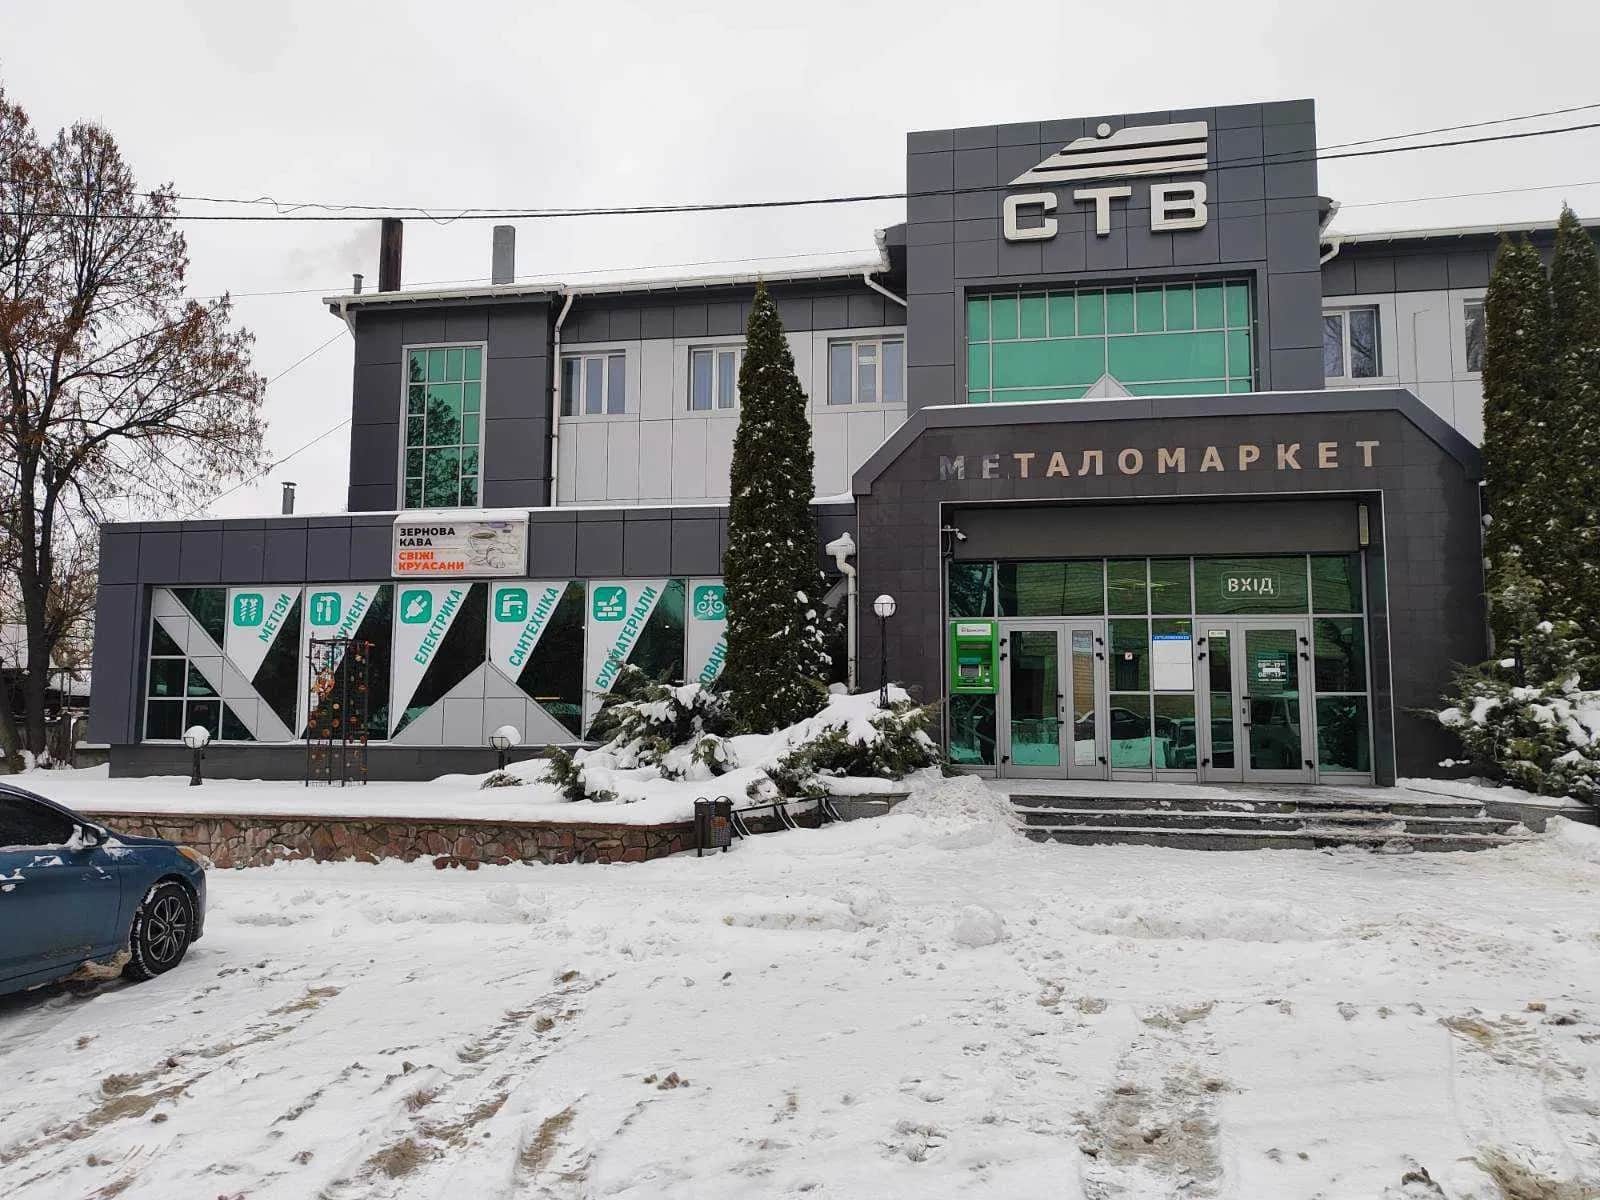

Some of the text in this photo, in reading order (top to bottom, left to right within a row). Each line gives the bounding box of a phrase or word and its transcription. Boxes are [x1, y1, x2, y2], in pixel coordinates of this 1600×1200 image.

[1004, 181, 1207, 240] СТВ
[938, 440, 1381, 481] МЕТАЛОМАРКЕТ
[400, 527, 456, 537] ЗЕРНОВА
[400, 538, 433, 547] КАВА
[398, 551, 434, 561] СВІЖІ
[398, 561, 465, 571] КРУАСАНИ
[1228, 577, 1274, 595] ВХІД
[258, 593, 292, 643] МЕТІЗИ
[413, 589, 463, 665] ЕЛЕКТРИКА
[508, 587, 560, 667] САНТЕХНІКА
